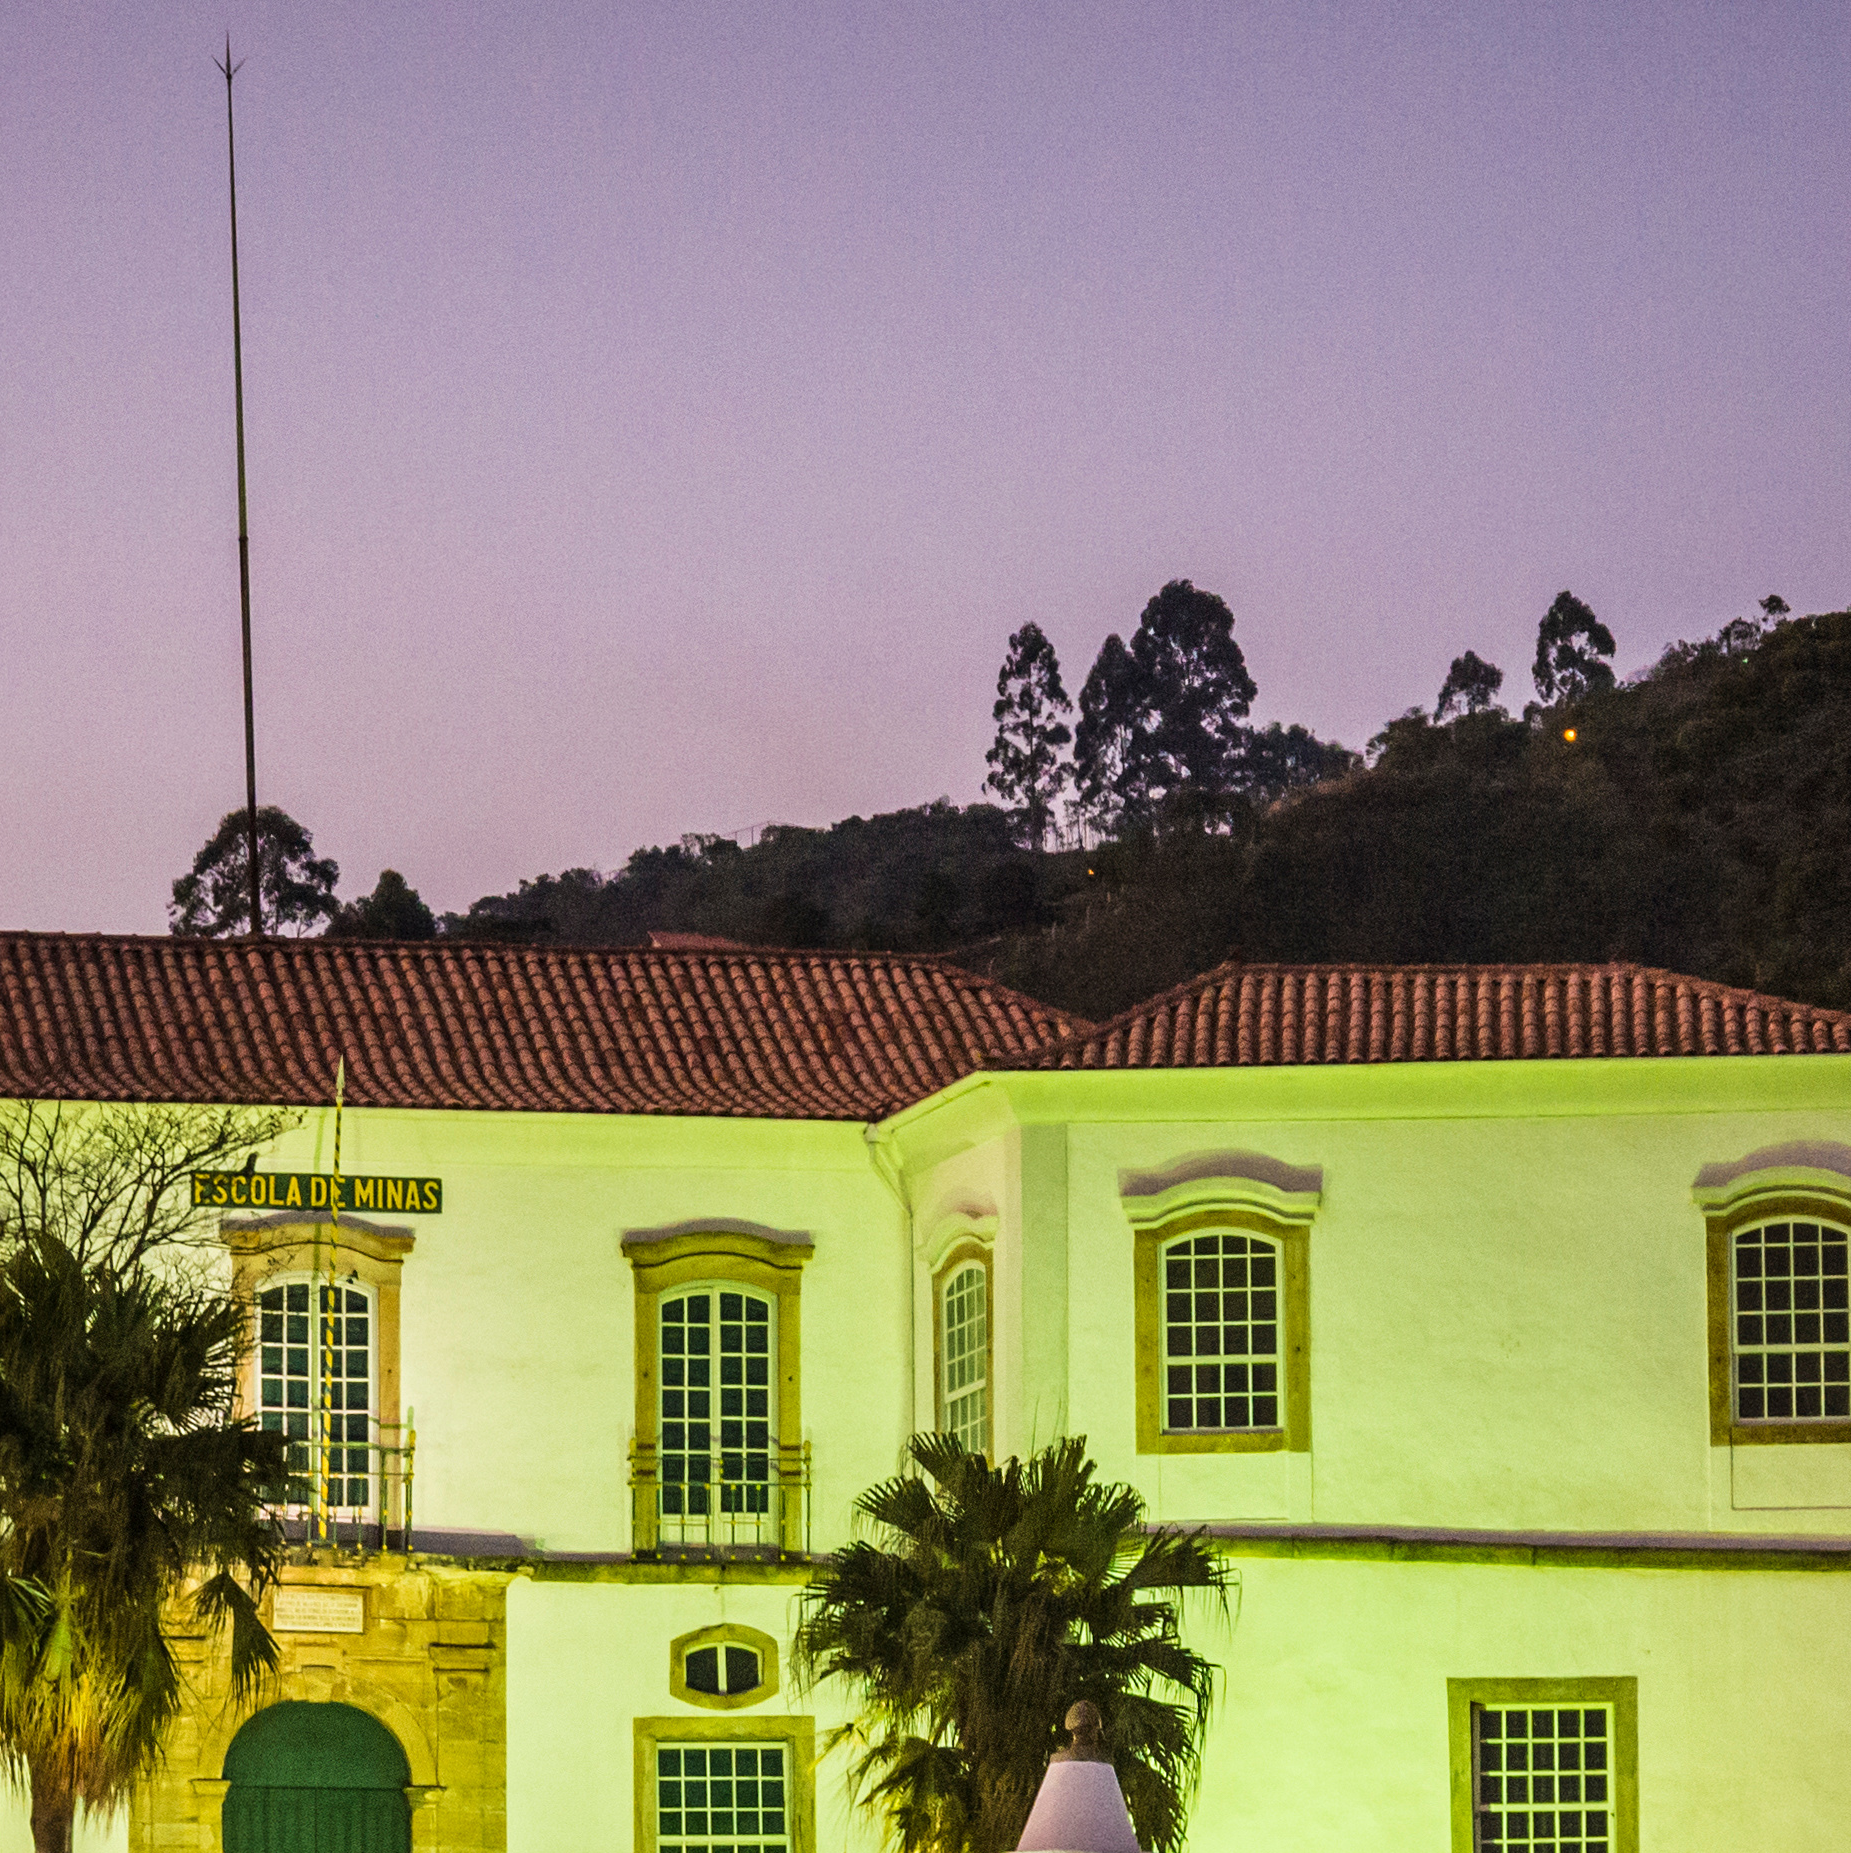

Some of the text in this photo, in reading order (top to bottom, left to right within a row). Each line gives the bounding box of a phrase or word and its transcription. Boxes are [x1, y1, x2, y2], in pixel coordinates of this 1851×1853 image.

[194, 1173, 439, 1211] ESCOLA DE MINAS
